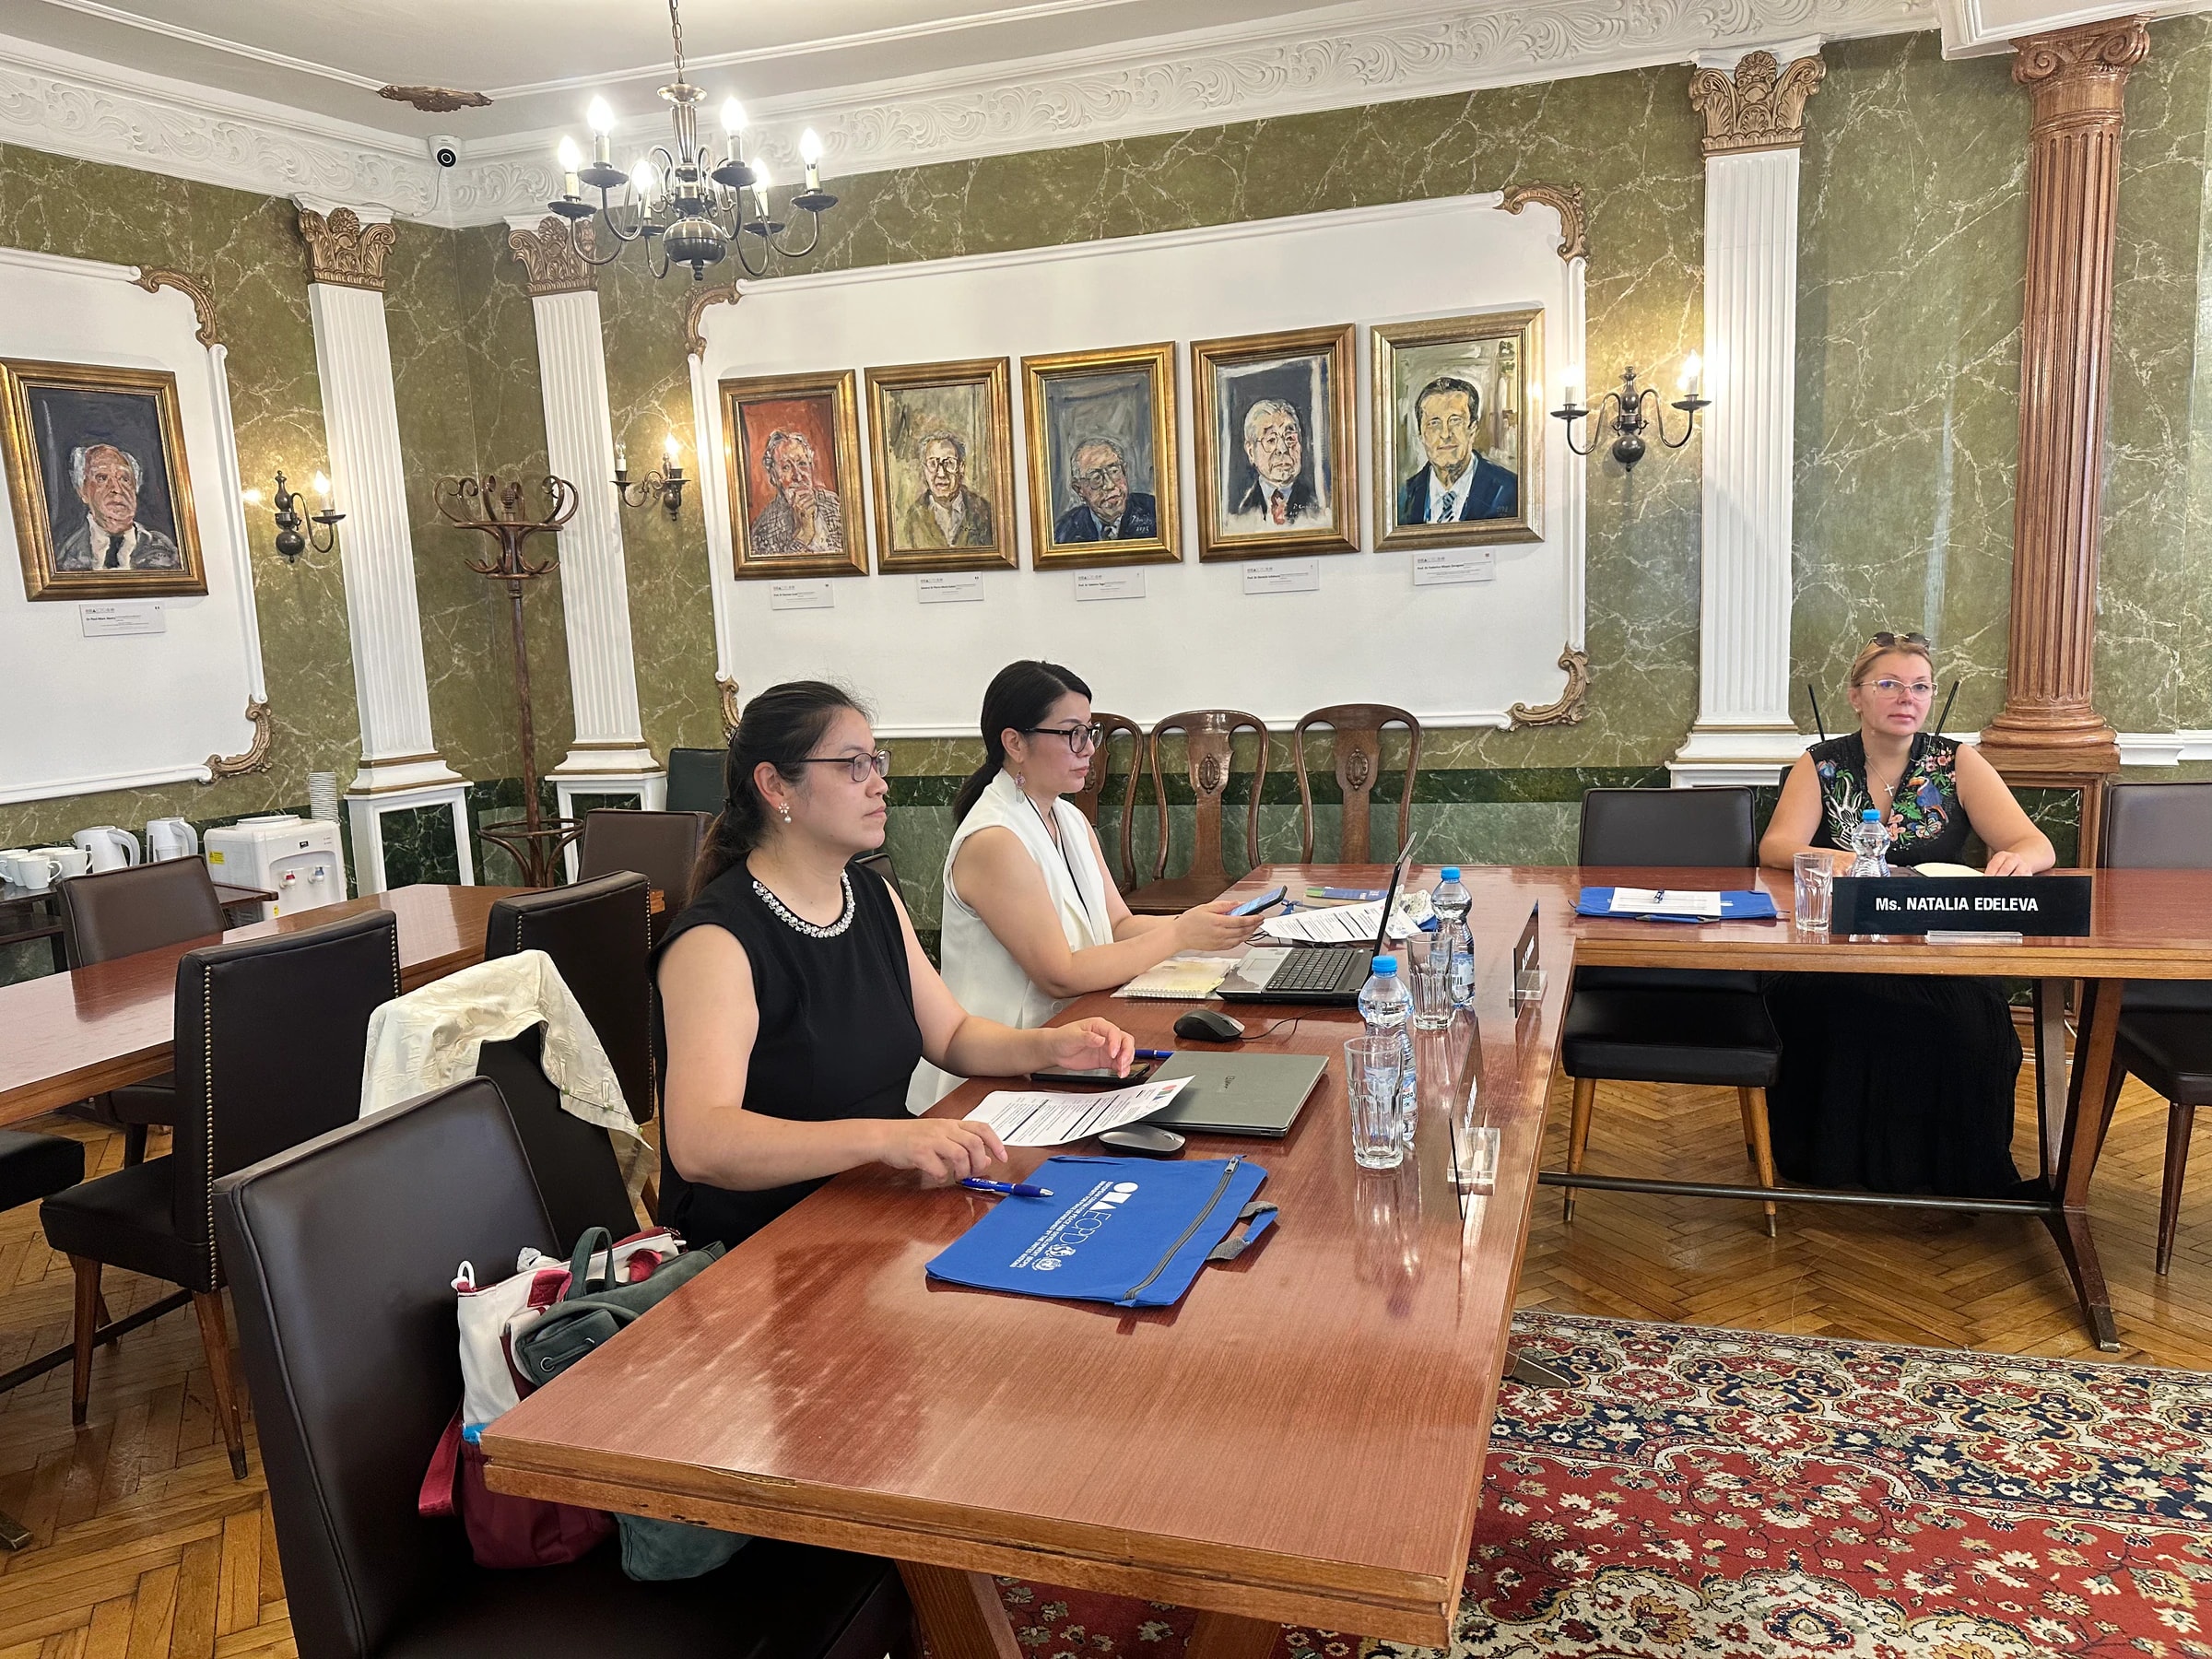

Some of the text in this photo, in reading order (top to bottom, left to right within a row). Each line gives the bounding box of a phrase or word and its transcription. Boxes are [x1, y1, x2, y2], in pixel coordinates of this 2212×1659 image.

[1876, 897, 2039, 912] Ms. NATALIA EDELEVA
[1059, 1210, 1112, 1244] ECPD
